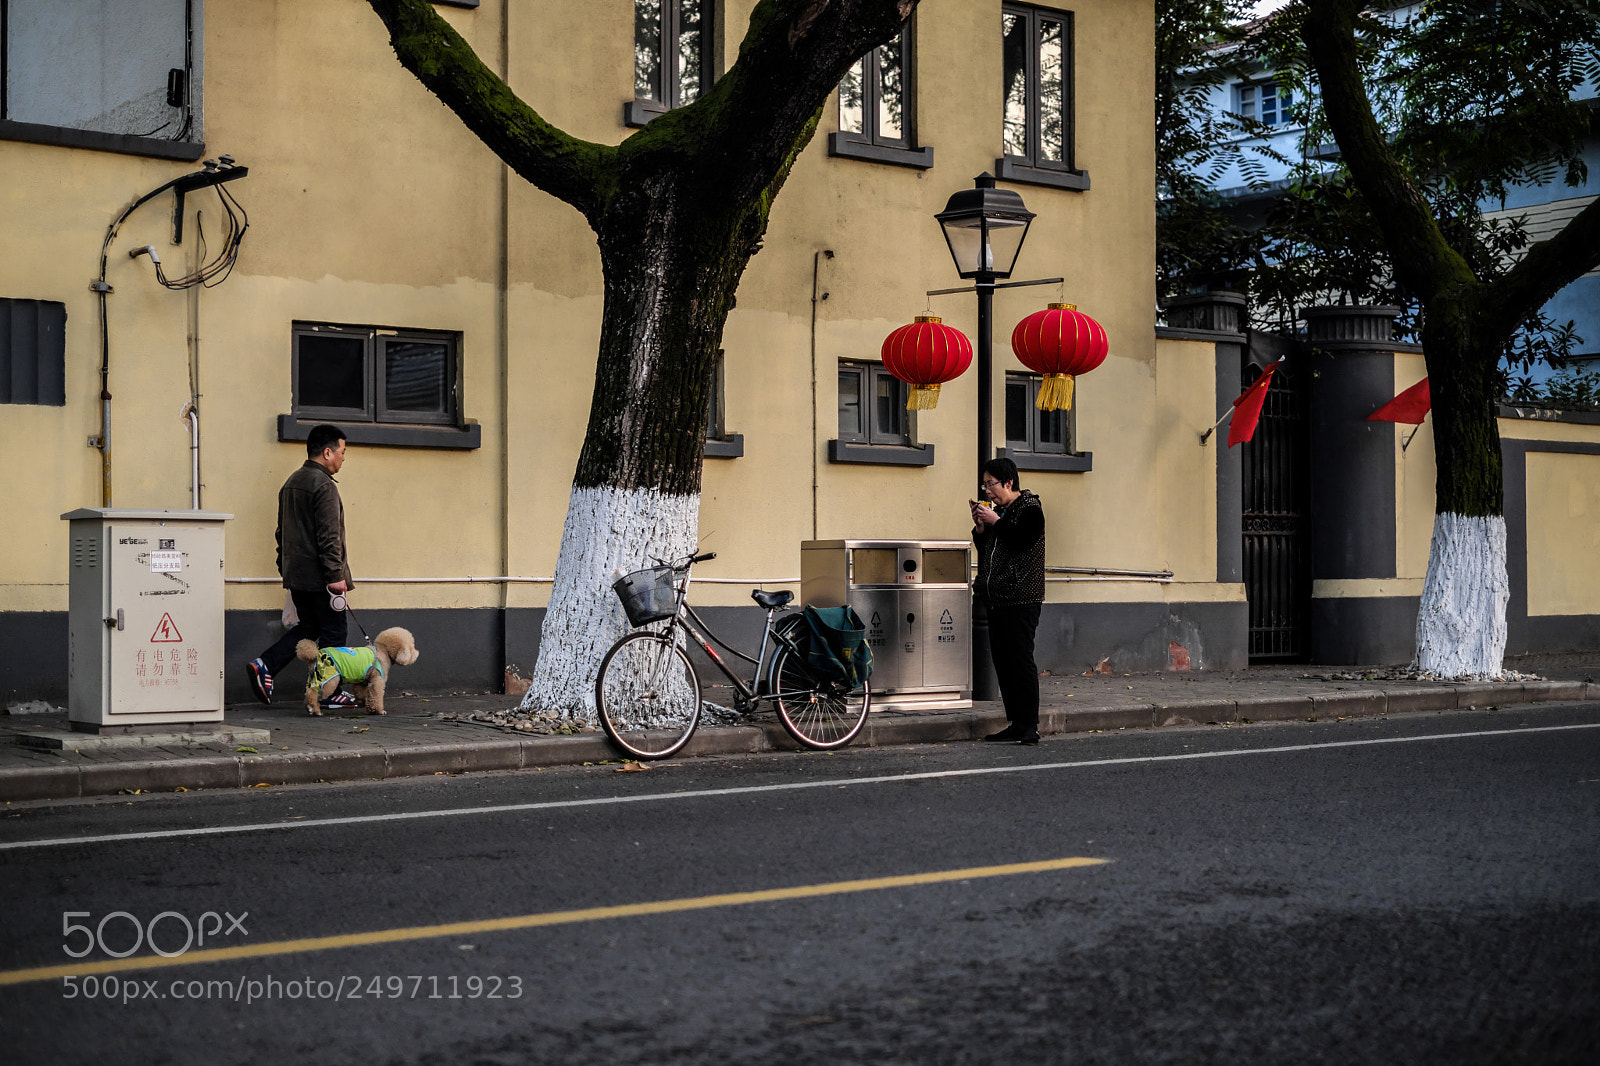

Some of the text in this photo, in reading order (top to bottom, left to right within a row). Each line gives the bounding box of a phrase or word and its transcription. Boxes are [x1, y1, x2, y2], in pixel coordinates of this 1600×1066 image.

[136, 648, 198, 662] 有电危险
[136, 663, 198, 676] 请勿靠近
